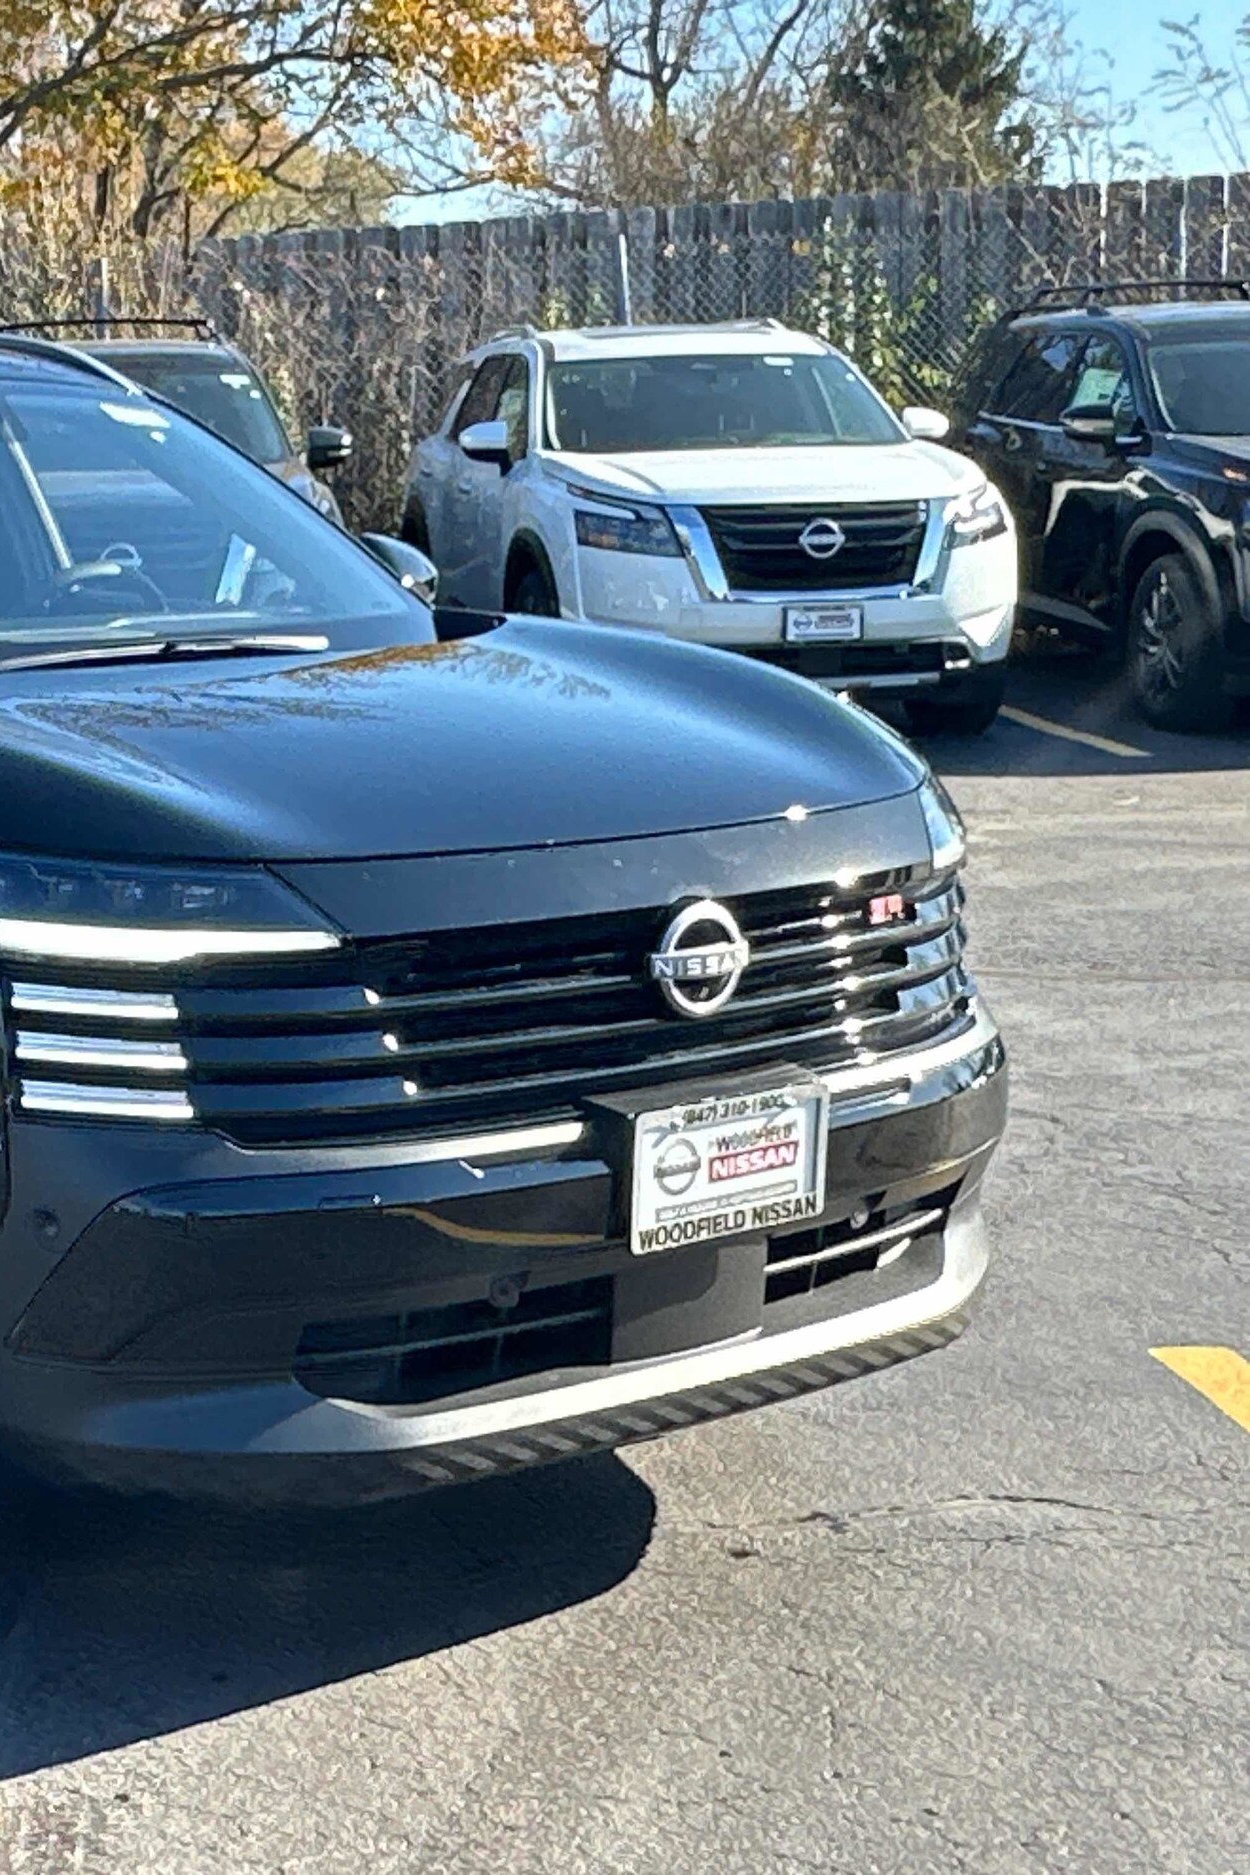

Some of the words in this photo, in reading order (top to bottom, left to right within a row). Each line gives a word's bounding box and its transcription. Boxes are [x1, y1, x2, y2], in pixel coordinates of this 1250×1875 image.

[710, 1143, 796, 1181] NISSAN
[638, 1211, 745, 1250] WOODFIELD
[751, 1193, 817, 1226] NISSAN
